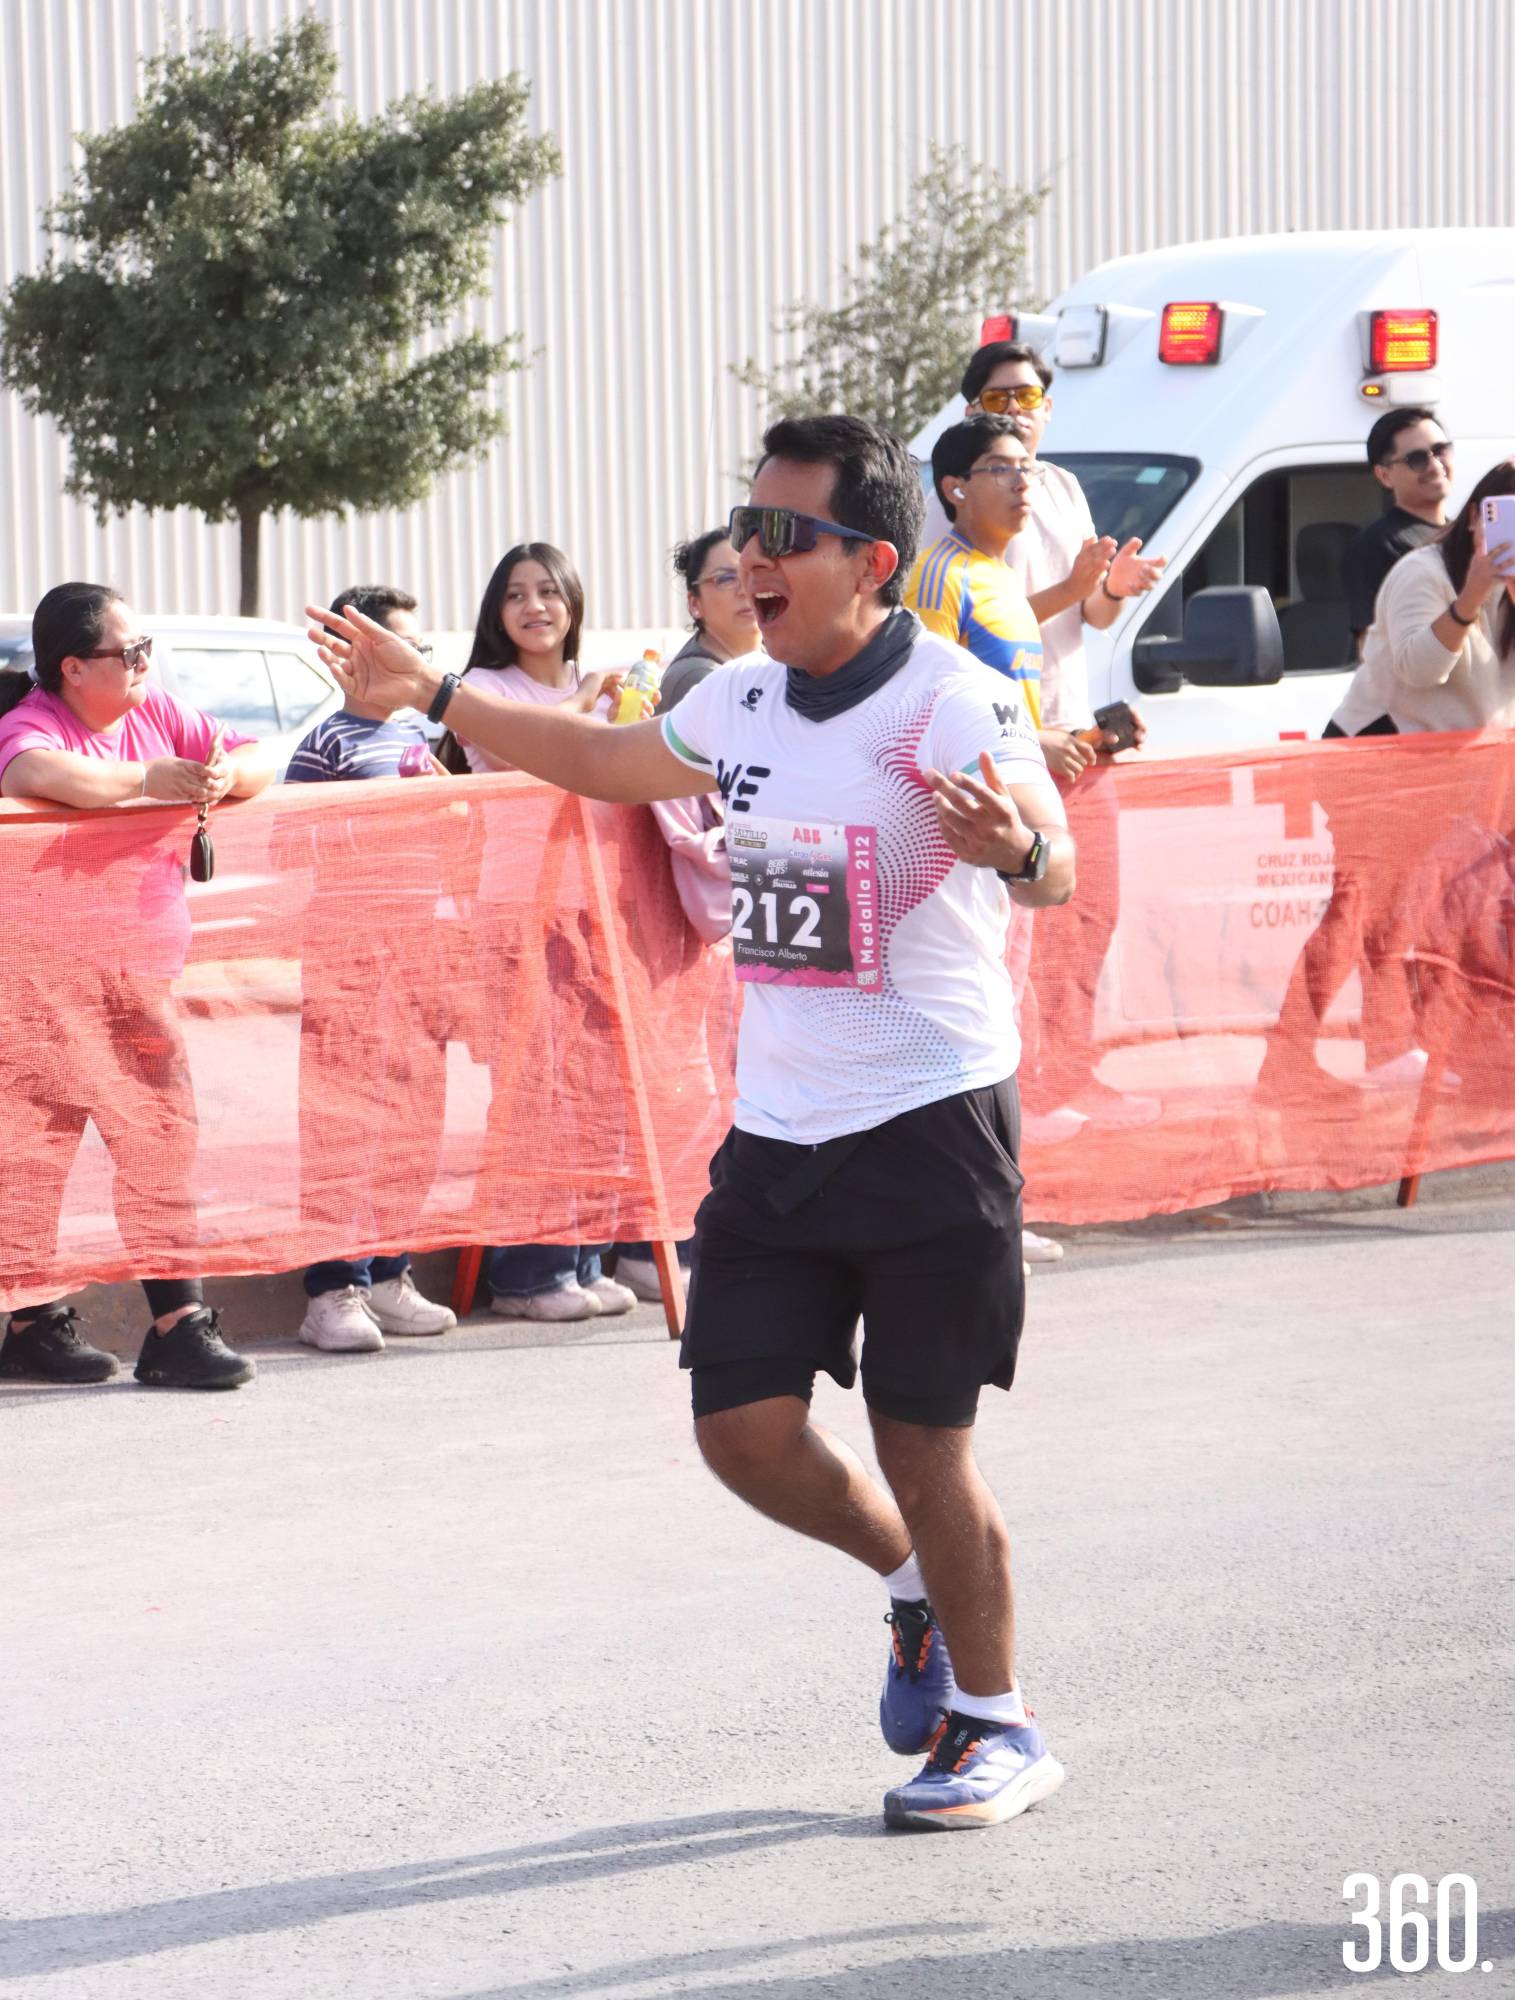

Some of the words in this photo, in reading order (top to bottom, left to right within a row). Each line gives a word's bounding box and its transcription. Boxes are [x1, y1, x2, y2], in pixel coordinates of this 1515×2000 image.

[791, 827, 821, 844] ABB
[855, 836, 870, 870] 212
[1257, 853, 1297, 868] CRUZ
[732, 888, 821, 949] 212
[857, 880, 875, 963] Medalla
[737, 943, 776, 958] Francisco
[777, 948, 808, 961] Alberto
